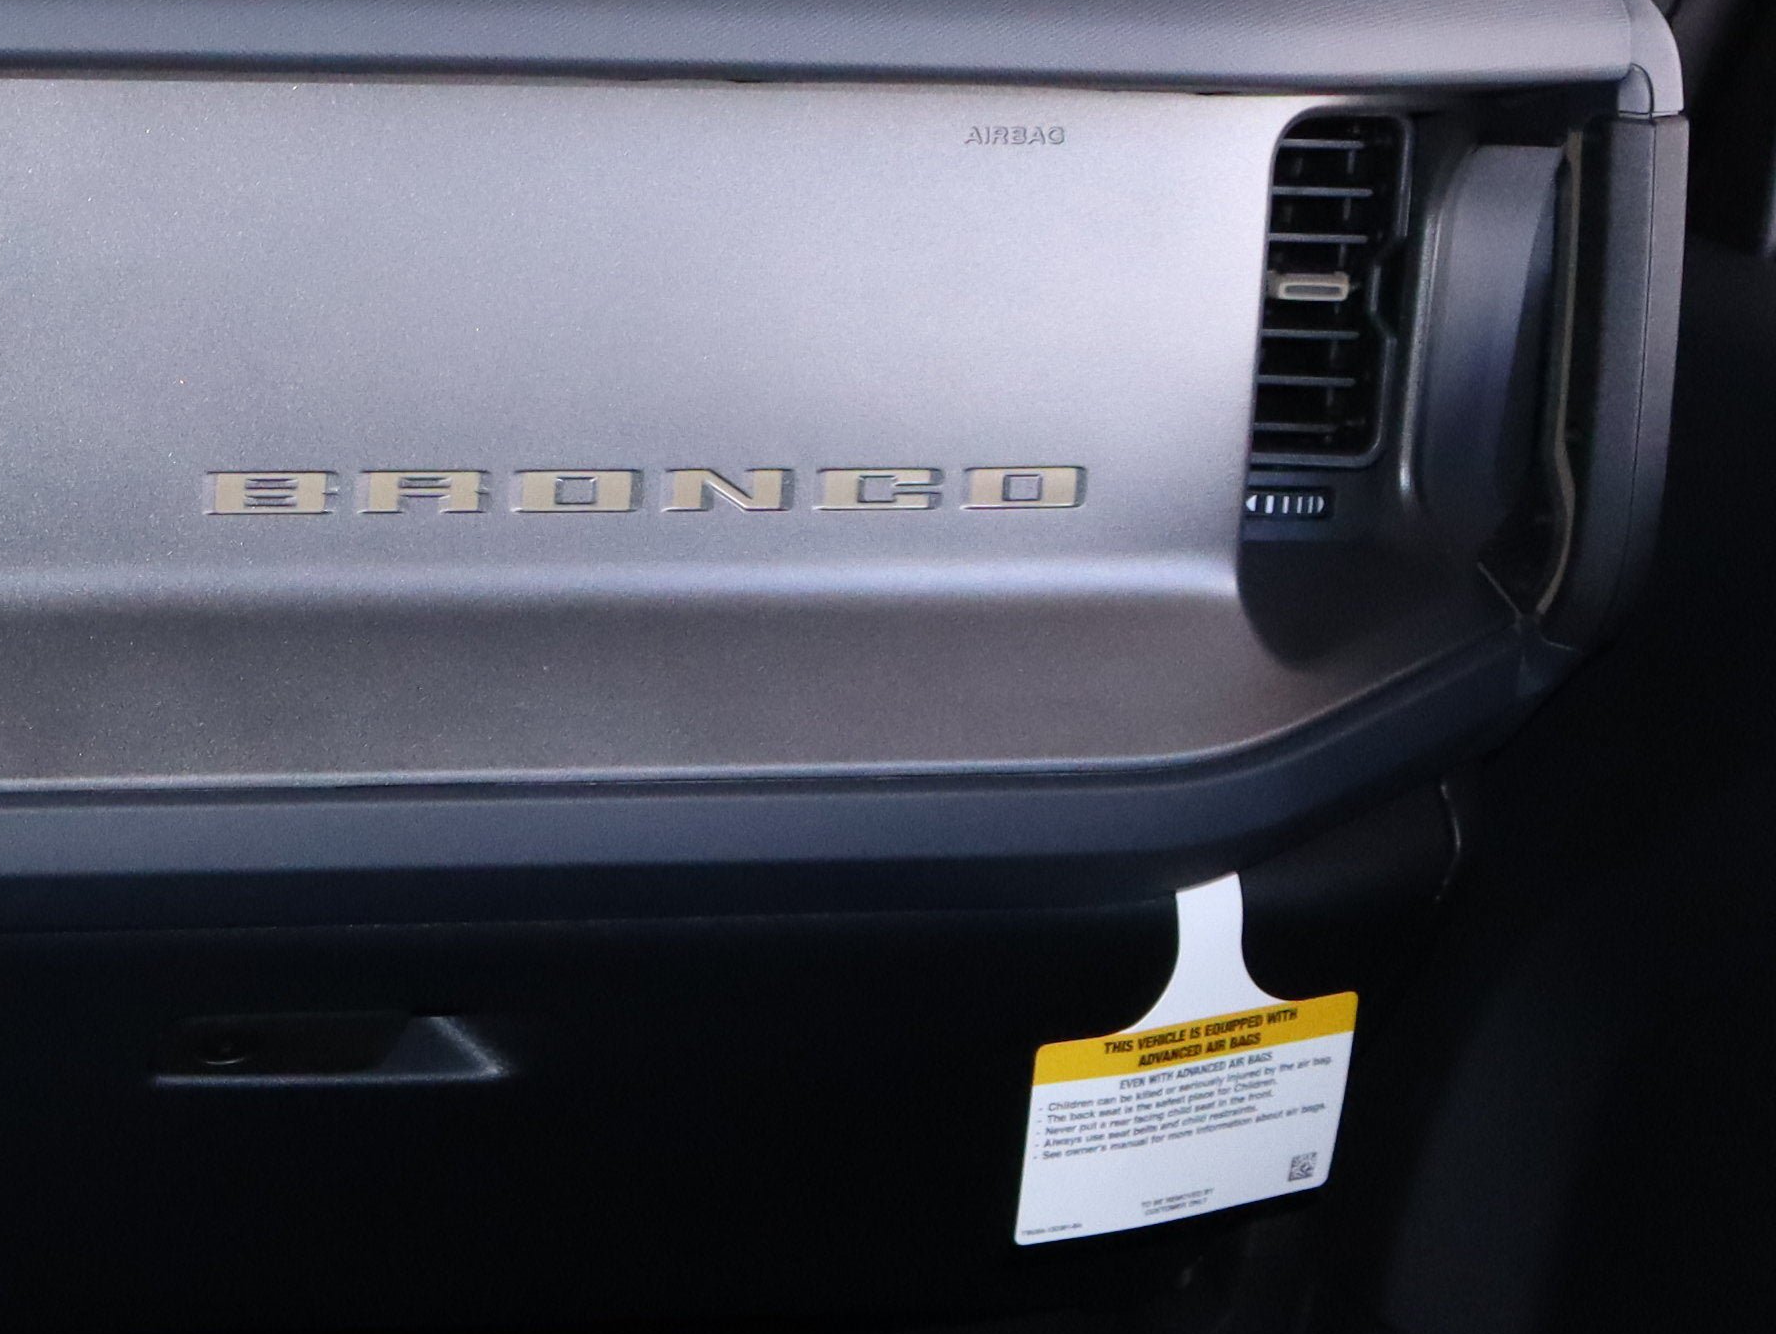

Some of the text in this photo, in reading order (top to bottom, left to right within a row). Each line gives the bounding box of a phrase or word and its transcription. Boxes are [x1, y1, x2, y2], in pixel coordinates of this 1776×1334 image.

[963, 124, 1066, 147] AIRBAG
[202, 464, 1088, 517] BRONCO
[1105, 1009, 1298, 1055] THIS VEHICLE IS EQUIPPED WITH
[1139, 1033, 1262, 1067] ADVANCED AIR BAGS
